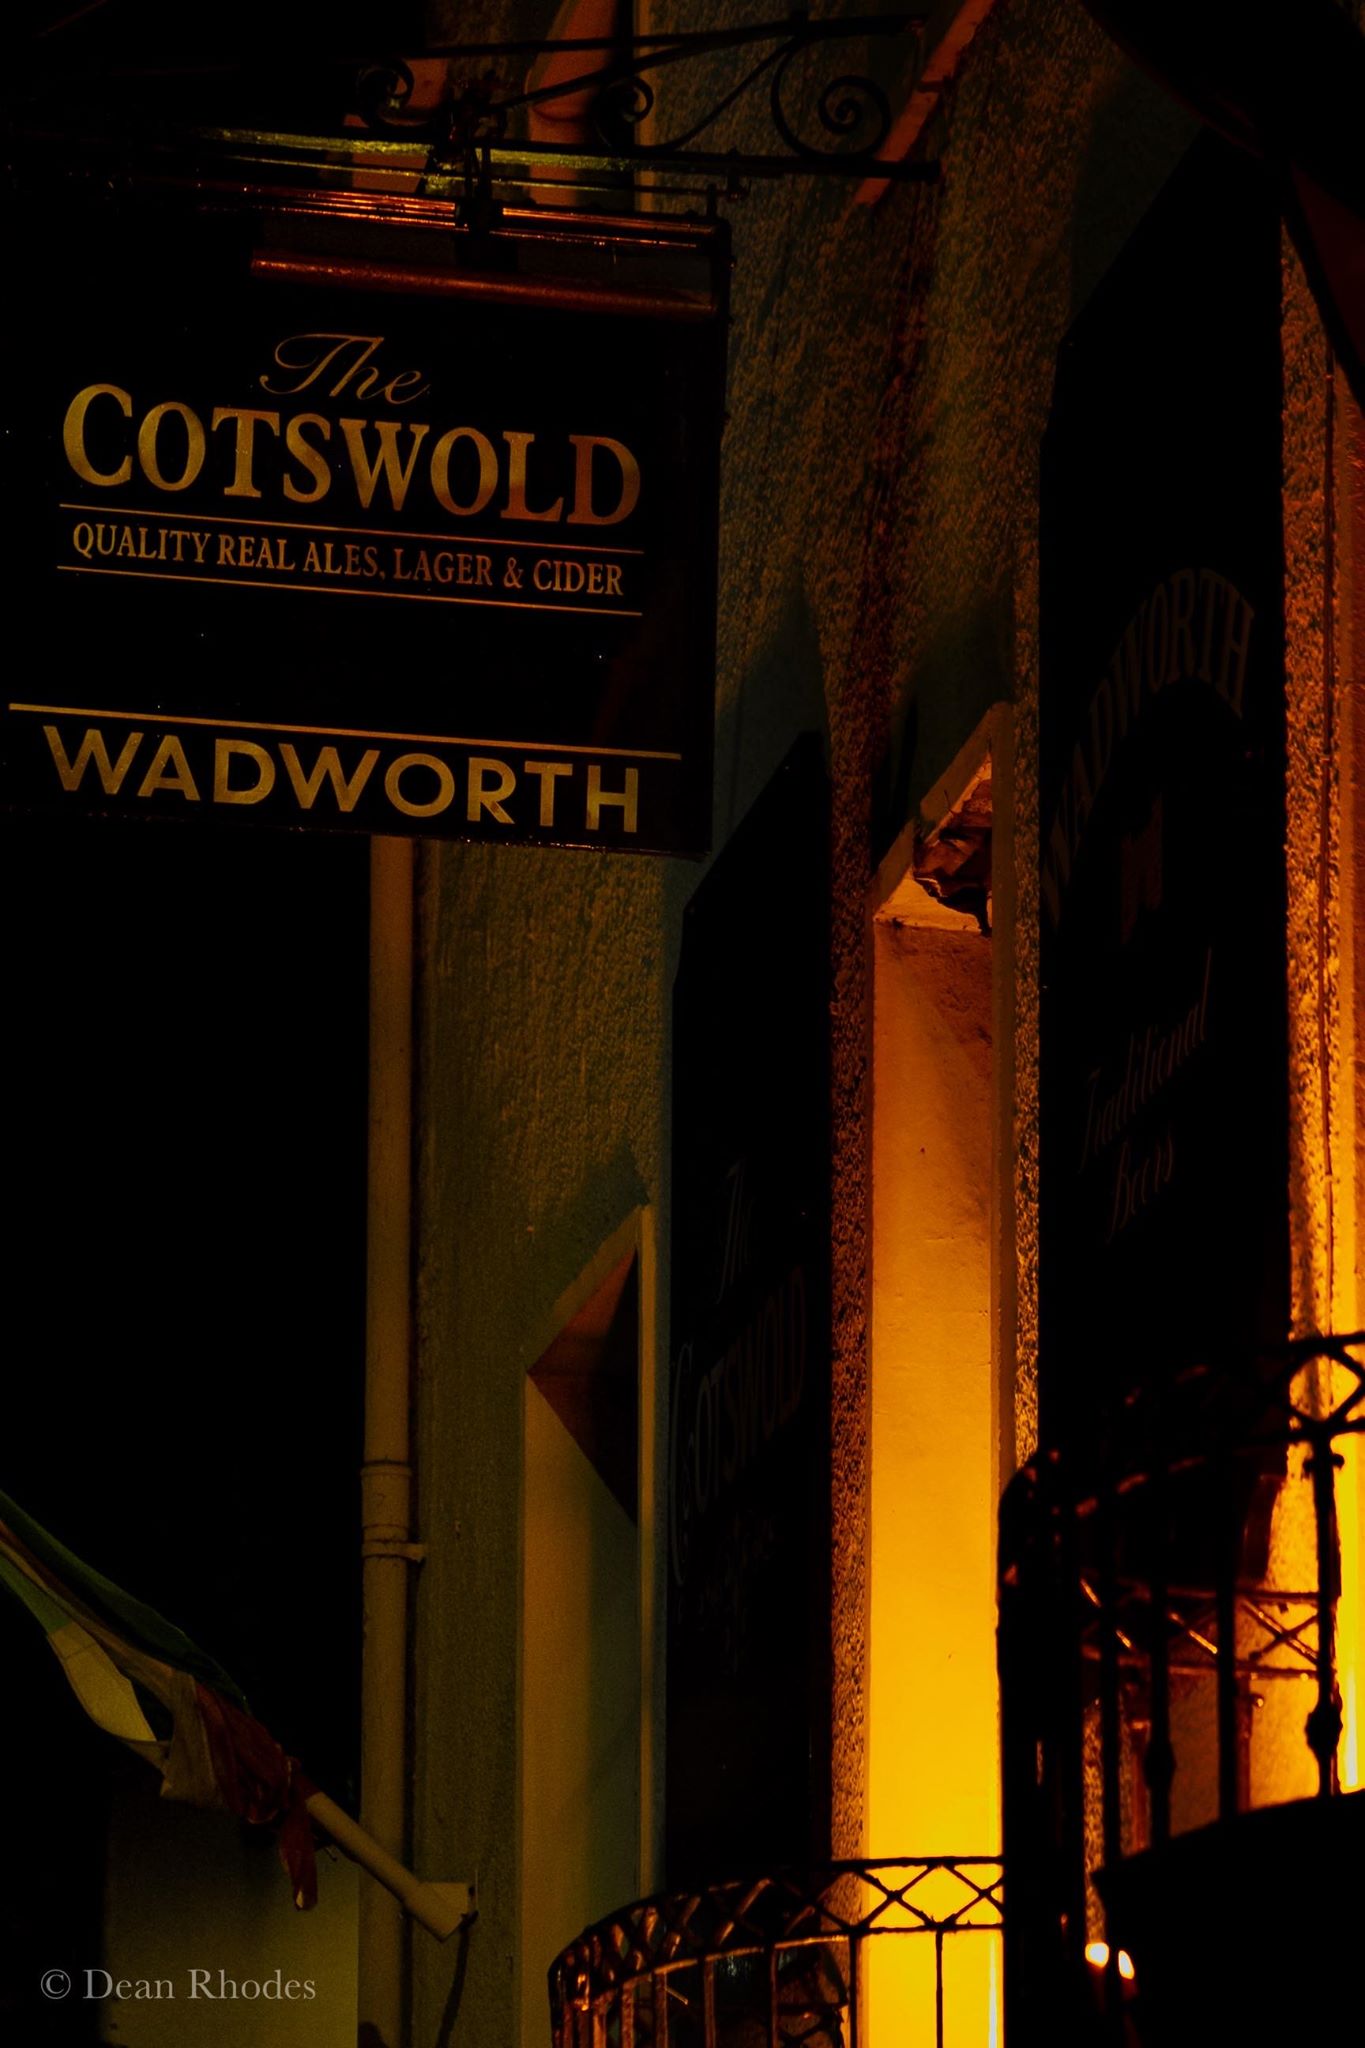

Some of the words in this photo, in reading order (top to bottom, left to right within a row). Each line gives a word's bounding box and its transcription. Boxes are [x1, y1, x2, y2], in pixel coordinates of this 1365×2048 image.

[258, 332, 432, 405] The
[62, 384, 641, 527] COTSWOLD
[72, 522, 211, 564] QUALITY
[216, 535, 295, 572] REAL
[303, 541, 385, 581] ALES,
[394, 547, 493, 588] LAGER
[502, 556, 524, 590] &
[532, 558, 624, 598] CIDER
[42, 724, 640, 834] WADWORTH
[1040, 566, 1255, 932] WADWORTH
